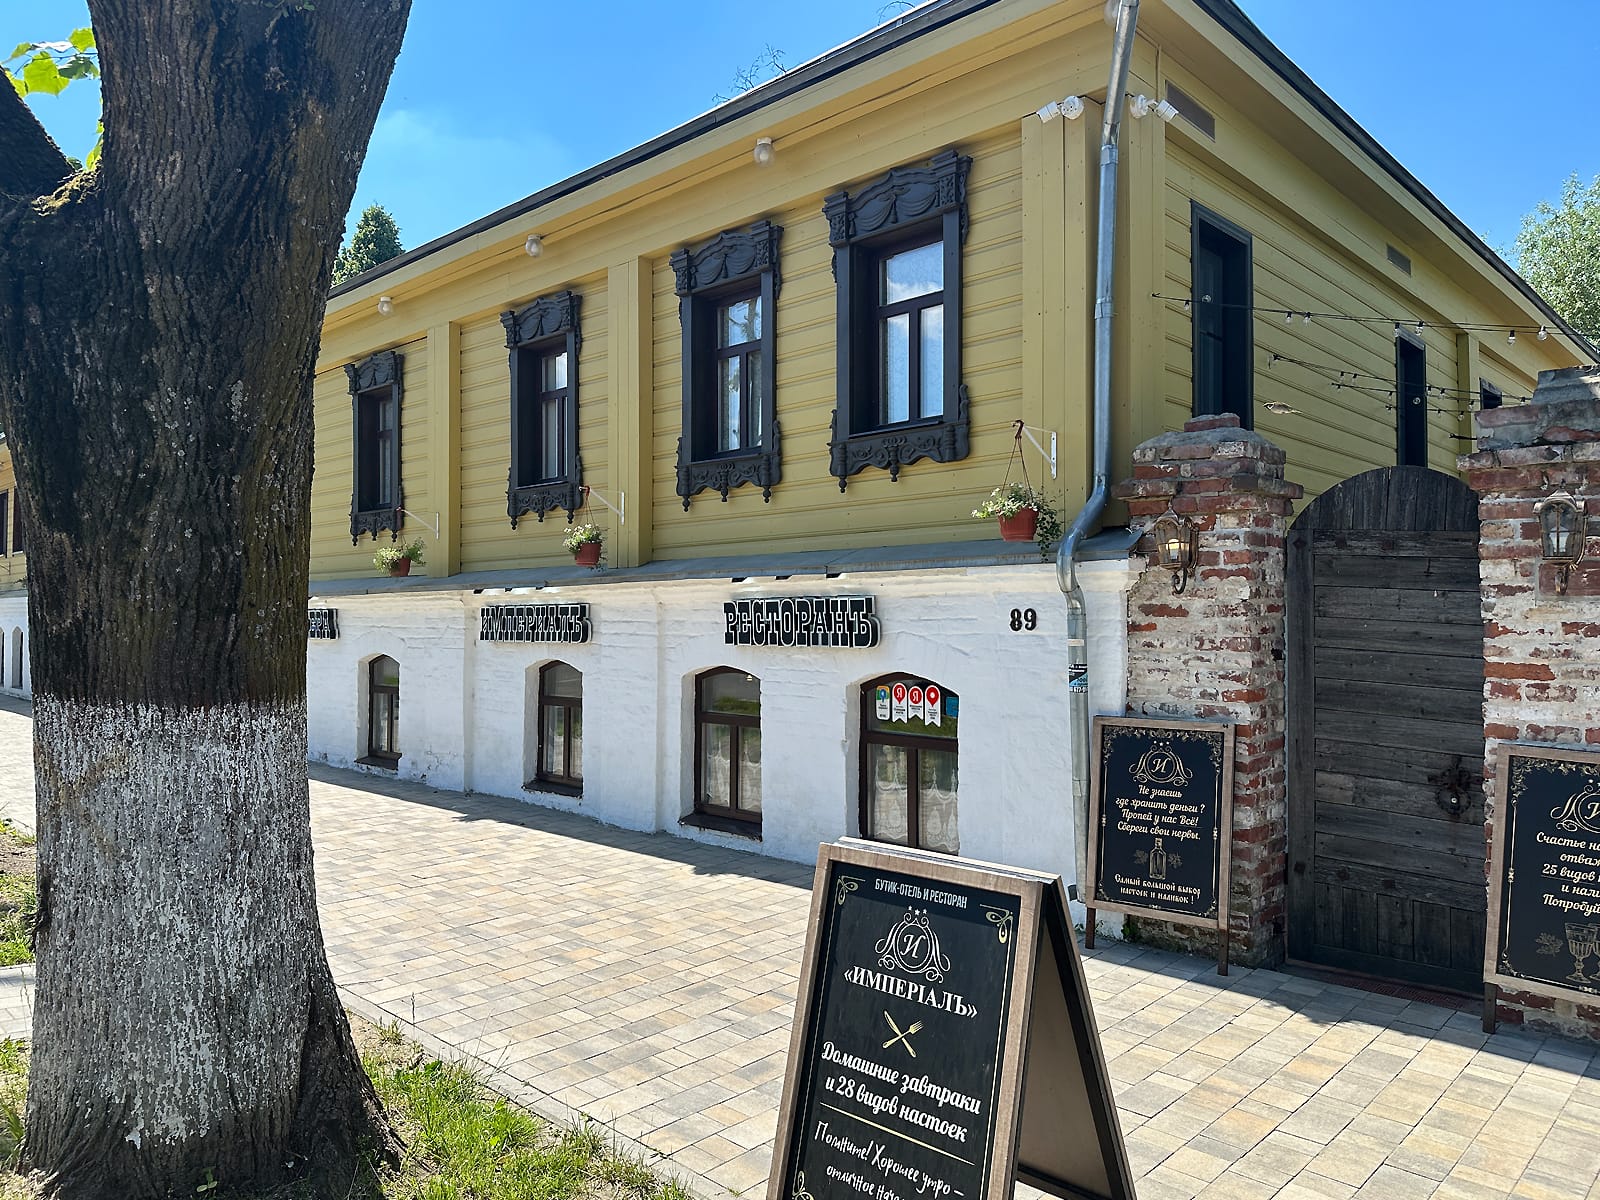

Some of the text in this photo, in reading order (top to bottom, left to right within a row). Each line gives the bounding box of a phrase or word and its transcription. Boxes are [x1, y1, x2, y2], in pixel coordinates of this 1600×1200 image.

[479, 603, 593, 643] ИМПЕРИАЛЪ
[723, 596, 881, 649] РЕСТОРАНЪ
[1010, 608, 1038, 631] 89
[1138, 784, 1182, 799] Не знаешь
[1115, 797, 1129, 808] где
[1130, 799, 1168, 810] хранить
[1168, 803, 1198, 814] деньги
[1121, 808, 1153, 822] Пропей
[1153, 814, 1160, 826] у
[1161, 815, 1178, 824] нас
[1117, 820, 1148, 835] Сбереги
[1149, 825, 1170, 836] свои
[1536, 831, 1587, 849] Счастье
[1542, 863, 1558, 875] 25
[1559, 866, 1595, 883] видов
[874, 878, 968, 909] БУТИК-ОТЕЛЬ И РЕСТОРАН
[1561, 884, 1569, 893] и
[821, 1041, 982, 1115] Домашние завтраки
[825, 1075, 968, 1143] и 28 видов настоек
[814, 1120, 874, 1161] Помните!
[871, 1143, 920, 1183] Хорошее
[915, 1172, 951, 1200] утро
[826, 1164, 874, 1196] отличное
